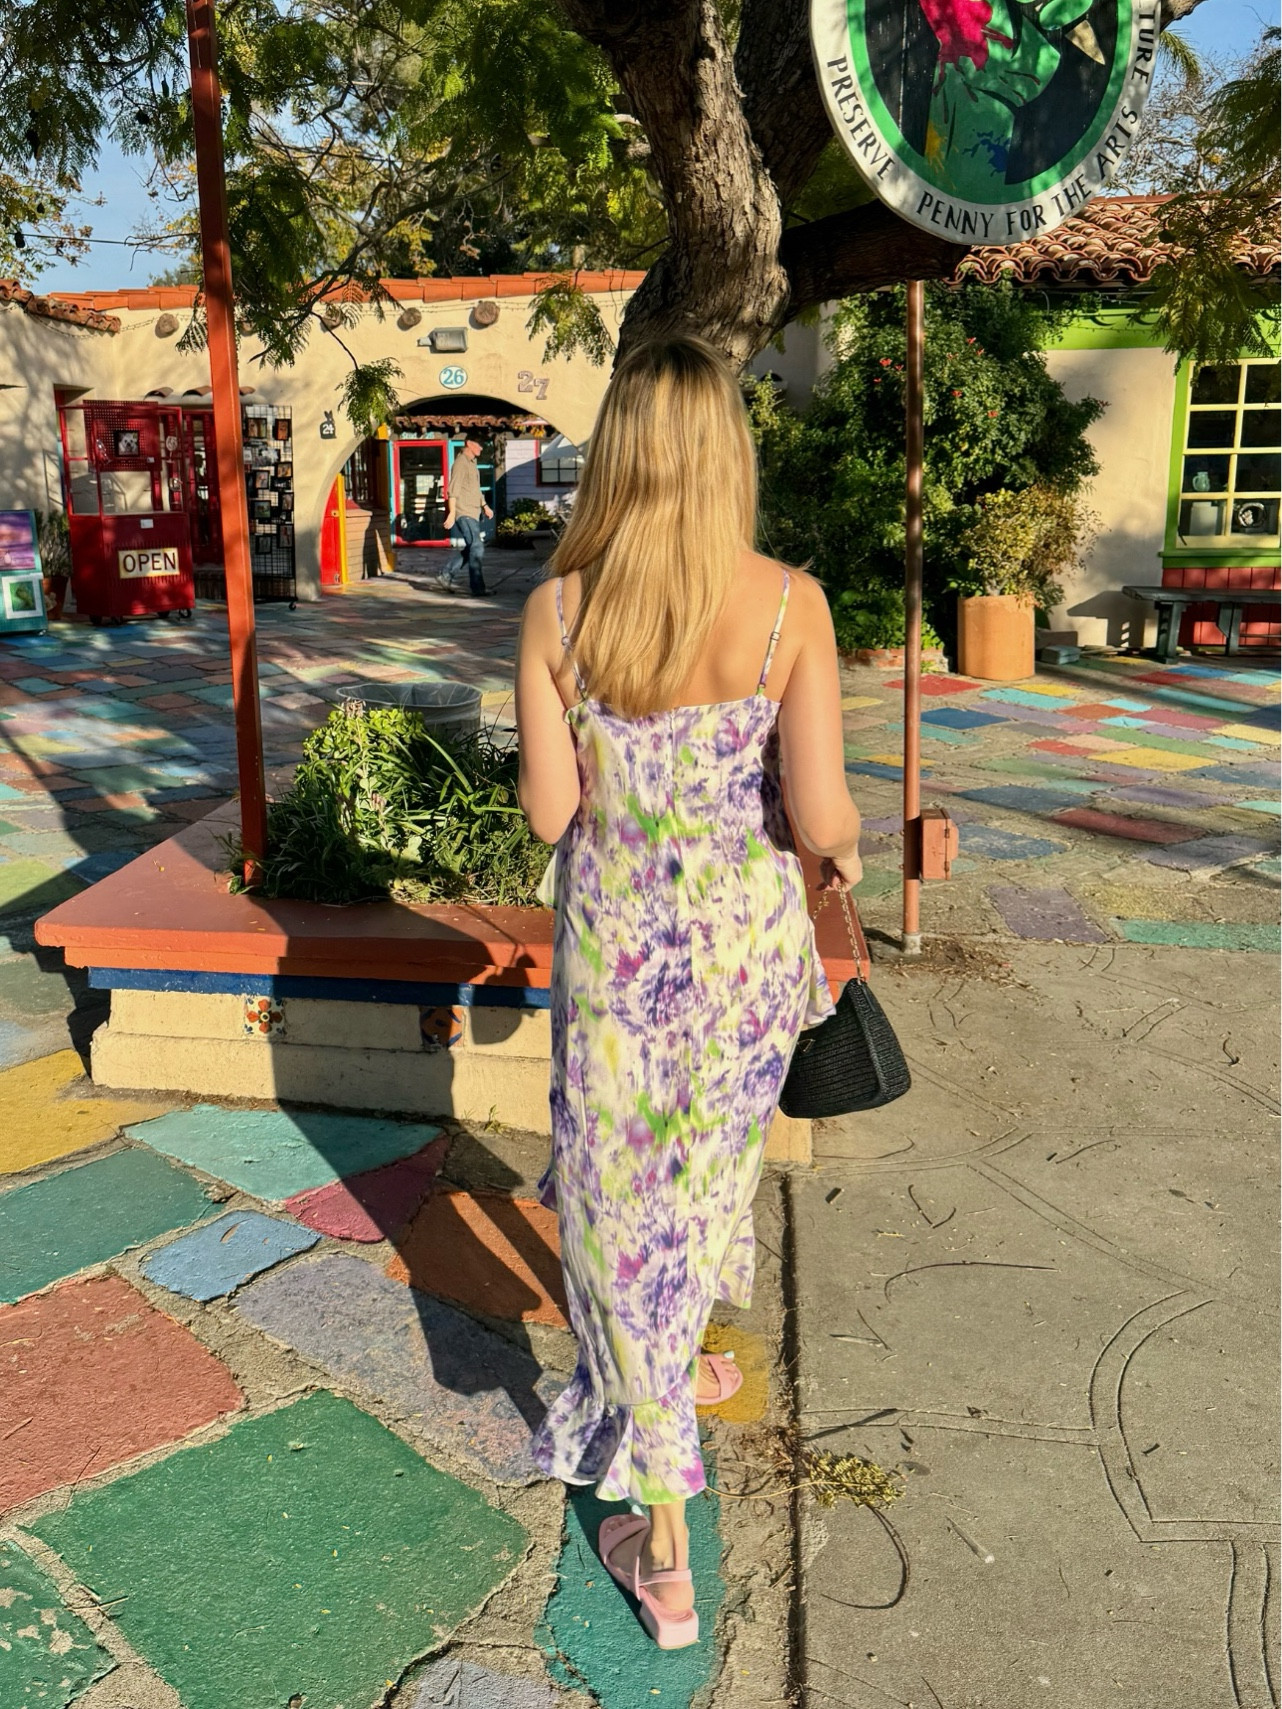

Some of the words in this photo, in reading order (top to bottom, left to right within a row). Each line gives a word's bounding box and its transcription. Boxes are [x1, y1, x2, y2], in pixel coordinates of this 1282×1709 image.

[1131, 0, 1156, 84] TURE
[827, 55, 896, 180] PRESERVE
[916, 190, 994, 238] PENNY
[1006, 204, 1048, 236] FOR
[1051, 174, 1093, 217] THE
[1095, 105, 1138, 180] ARTS
[443, 368, 464, 385] 26
[517, 370, 550, 401] 27
[322, 423, 335, 435] 24
[123, 552, 177, 573] OPEN
